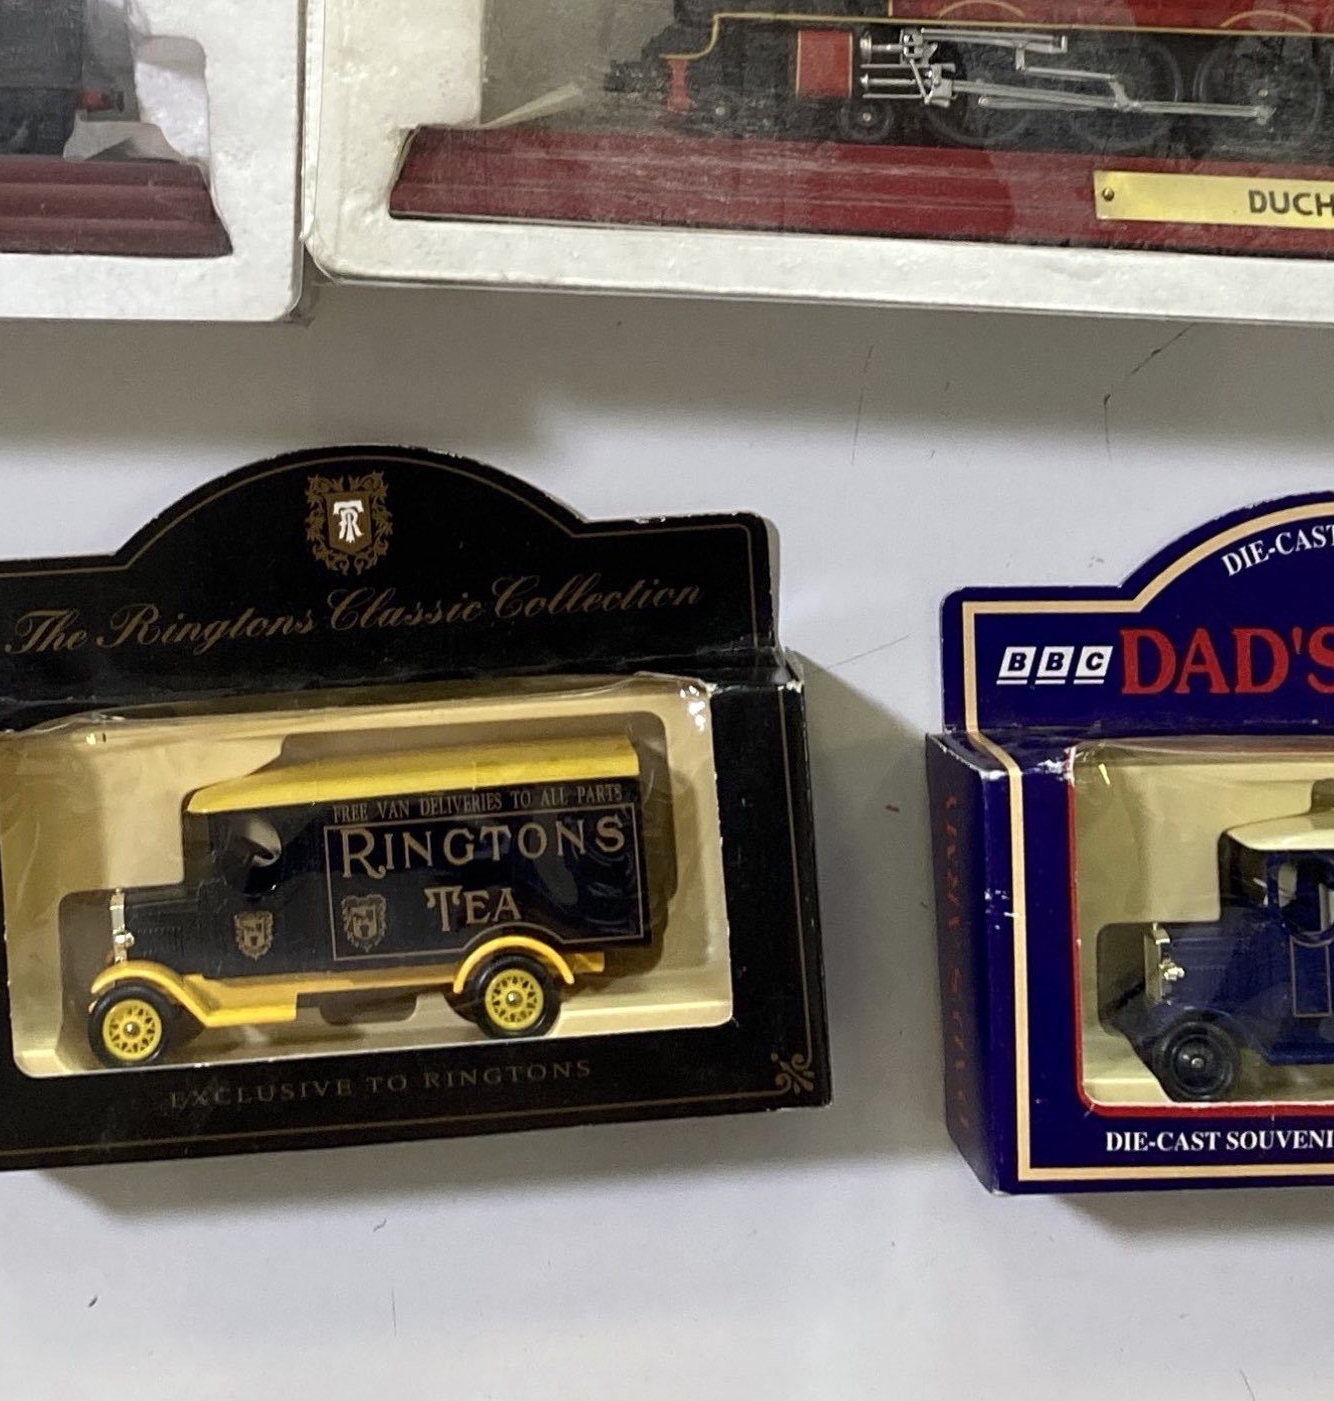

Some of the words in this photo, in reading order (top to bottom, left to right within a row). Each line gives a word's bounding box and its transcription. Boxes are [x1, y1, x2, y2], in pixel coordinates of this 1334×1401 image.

[4, 608, 88, 654] The
[95, 602, 315, 656] Ringtons
[326, 585, 486, 631] Classic
[491, 572, 703, 620] Collection
[1000, 647, 1112, 678] BBC
[332, 803, 368, 823] FREE
[377, 800, 410, 820] VAN
[420, 791, 503, 817] DELIVERIES
[510, 790, 532, 810] TO
[541, 787, 568, 807] ALL
[577, 783, 623, 804] PARTS
[339, 813, 626, 881] RINGTONS
[423, 884, 523, 933] TEA
[170, 1078, 354, 1109] EXCLUSIVE
[366, 1073, 408, 1094] TO
[423, 1059, 592, 1089] RINGTONS
[1105, 1130, 1222, 1152] DIE-CAST
